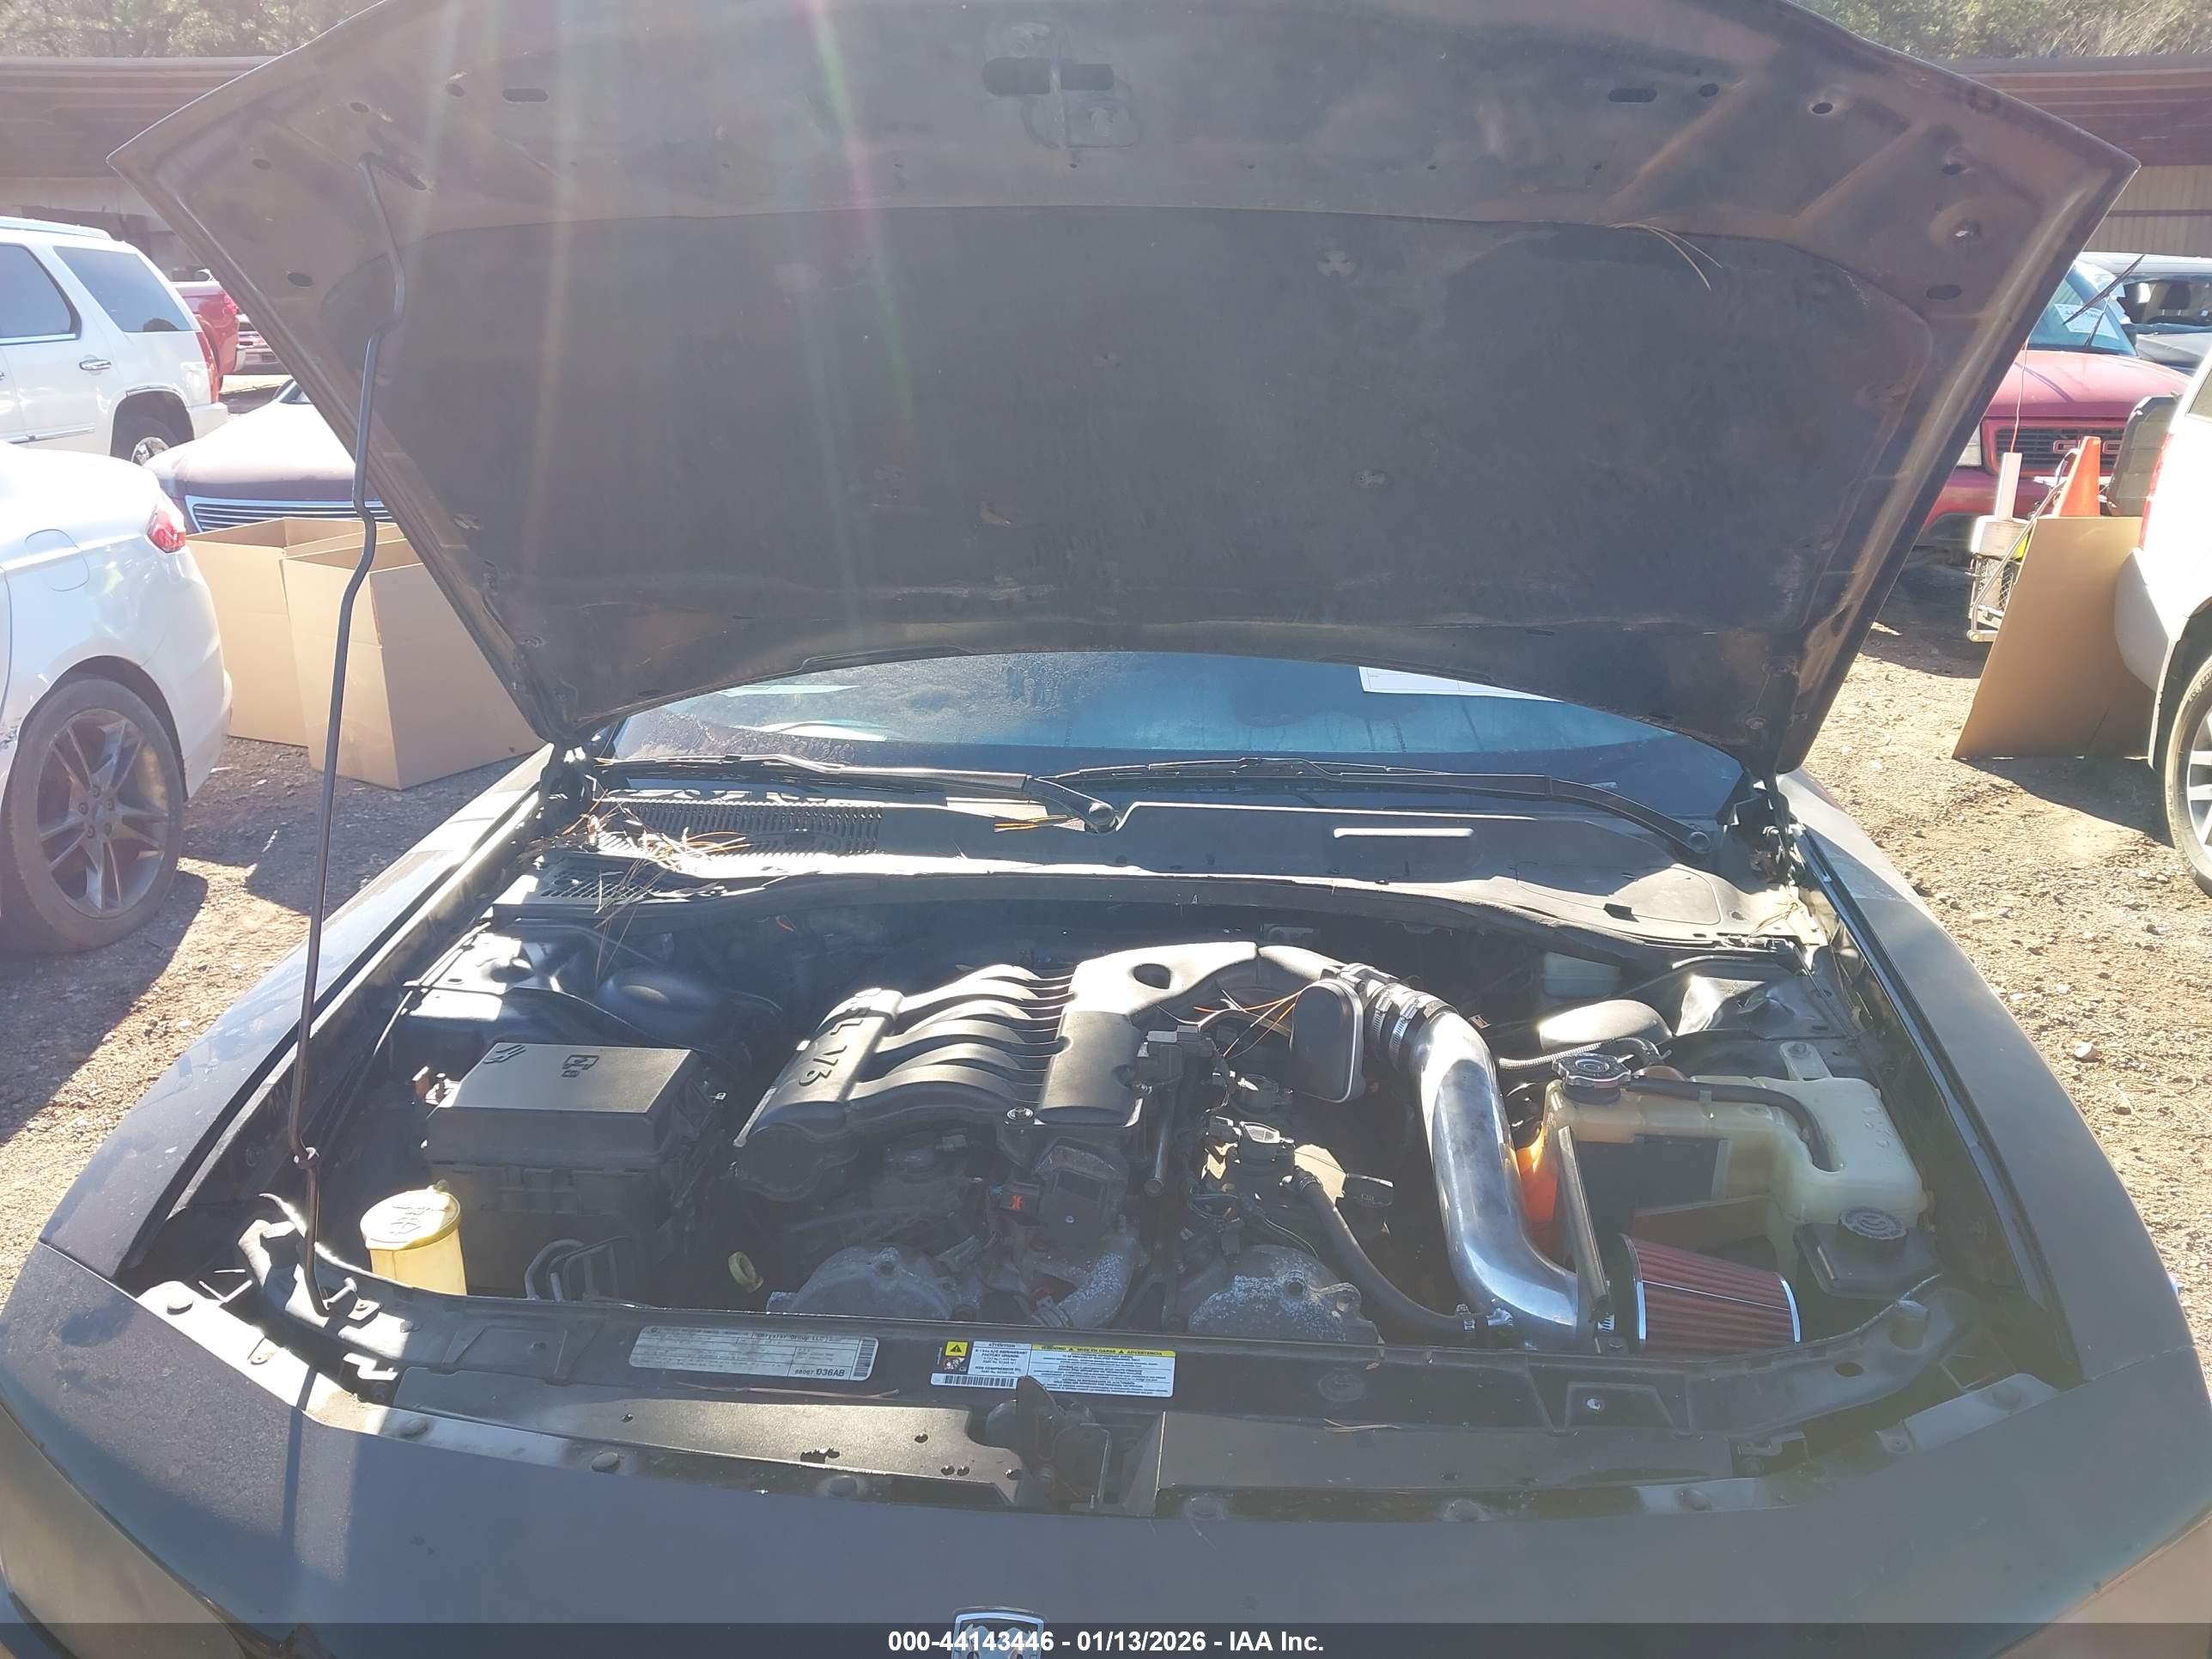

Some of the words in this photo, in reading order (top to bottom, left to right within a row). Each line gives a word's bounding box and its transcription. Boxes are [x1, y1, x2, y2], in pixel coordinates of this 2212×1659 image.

[2053, 439, 2123, 455] GC
[798, 1044, 848, 1087] V6
[816, 1368, 846, 1377] 036AB
